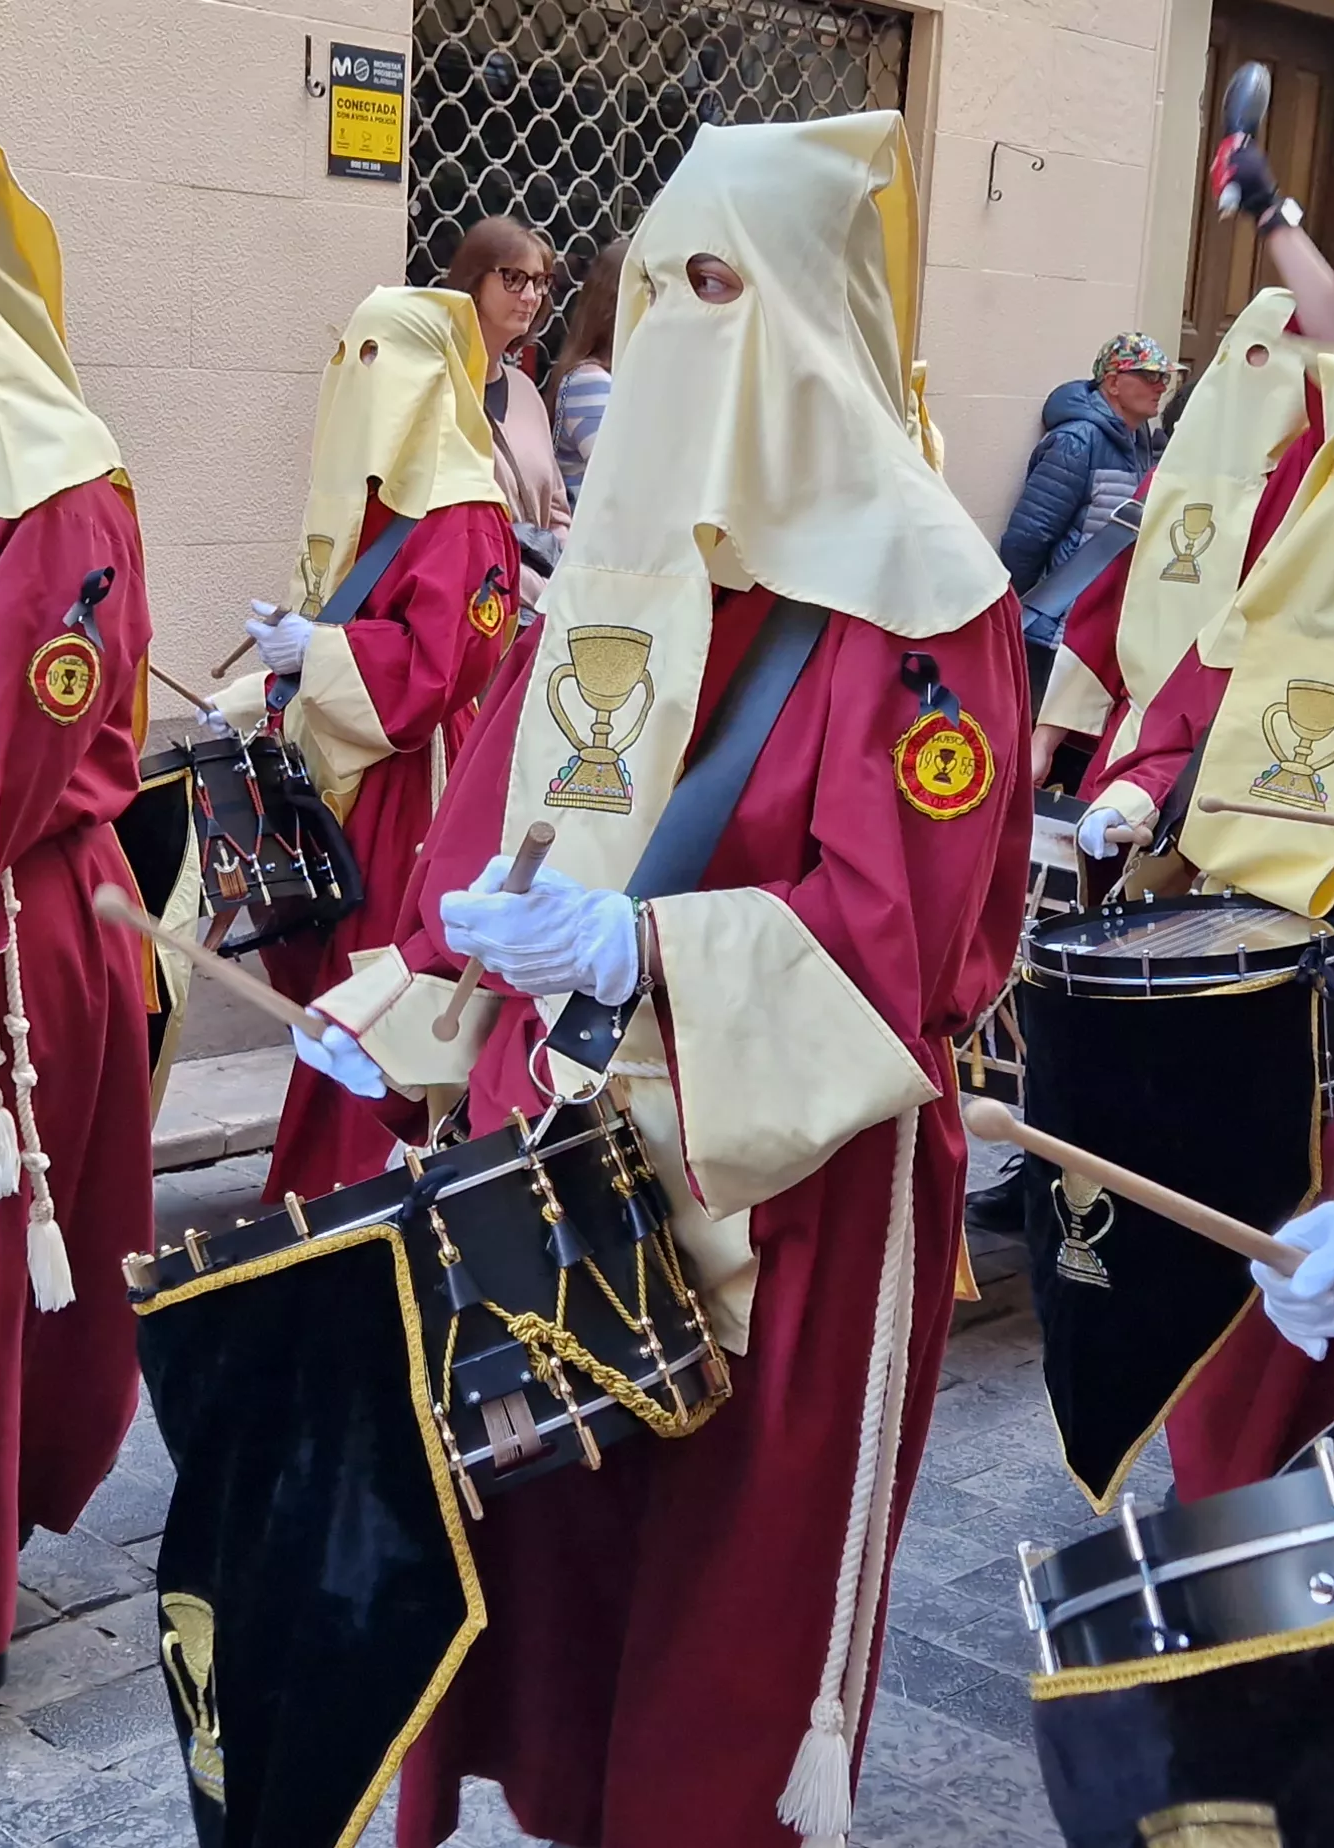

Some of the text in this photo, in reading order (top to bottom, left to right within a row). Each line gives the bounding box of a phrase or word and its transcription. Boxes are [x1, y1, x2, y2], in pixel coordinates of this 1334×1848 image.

[337, 98, 397, 116] CONECTADA
[932, 735, 967, 747] HUESCA
[919, 750, 932, 770] 19
[960, 756, 975, 777] 55
